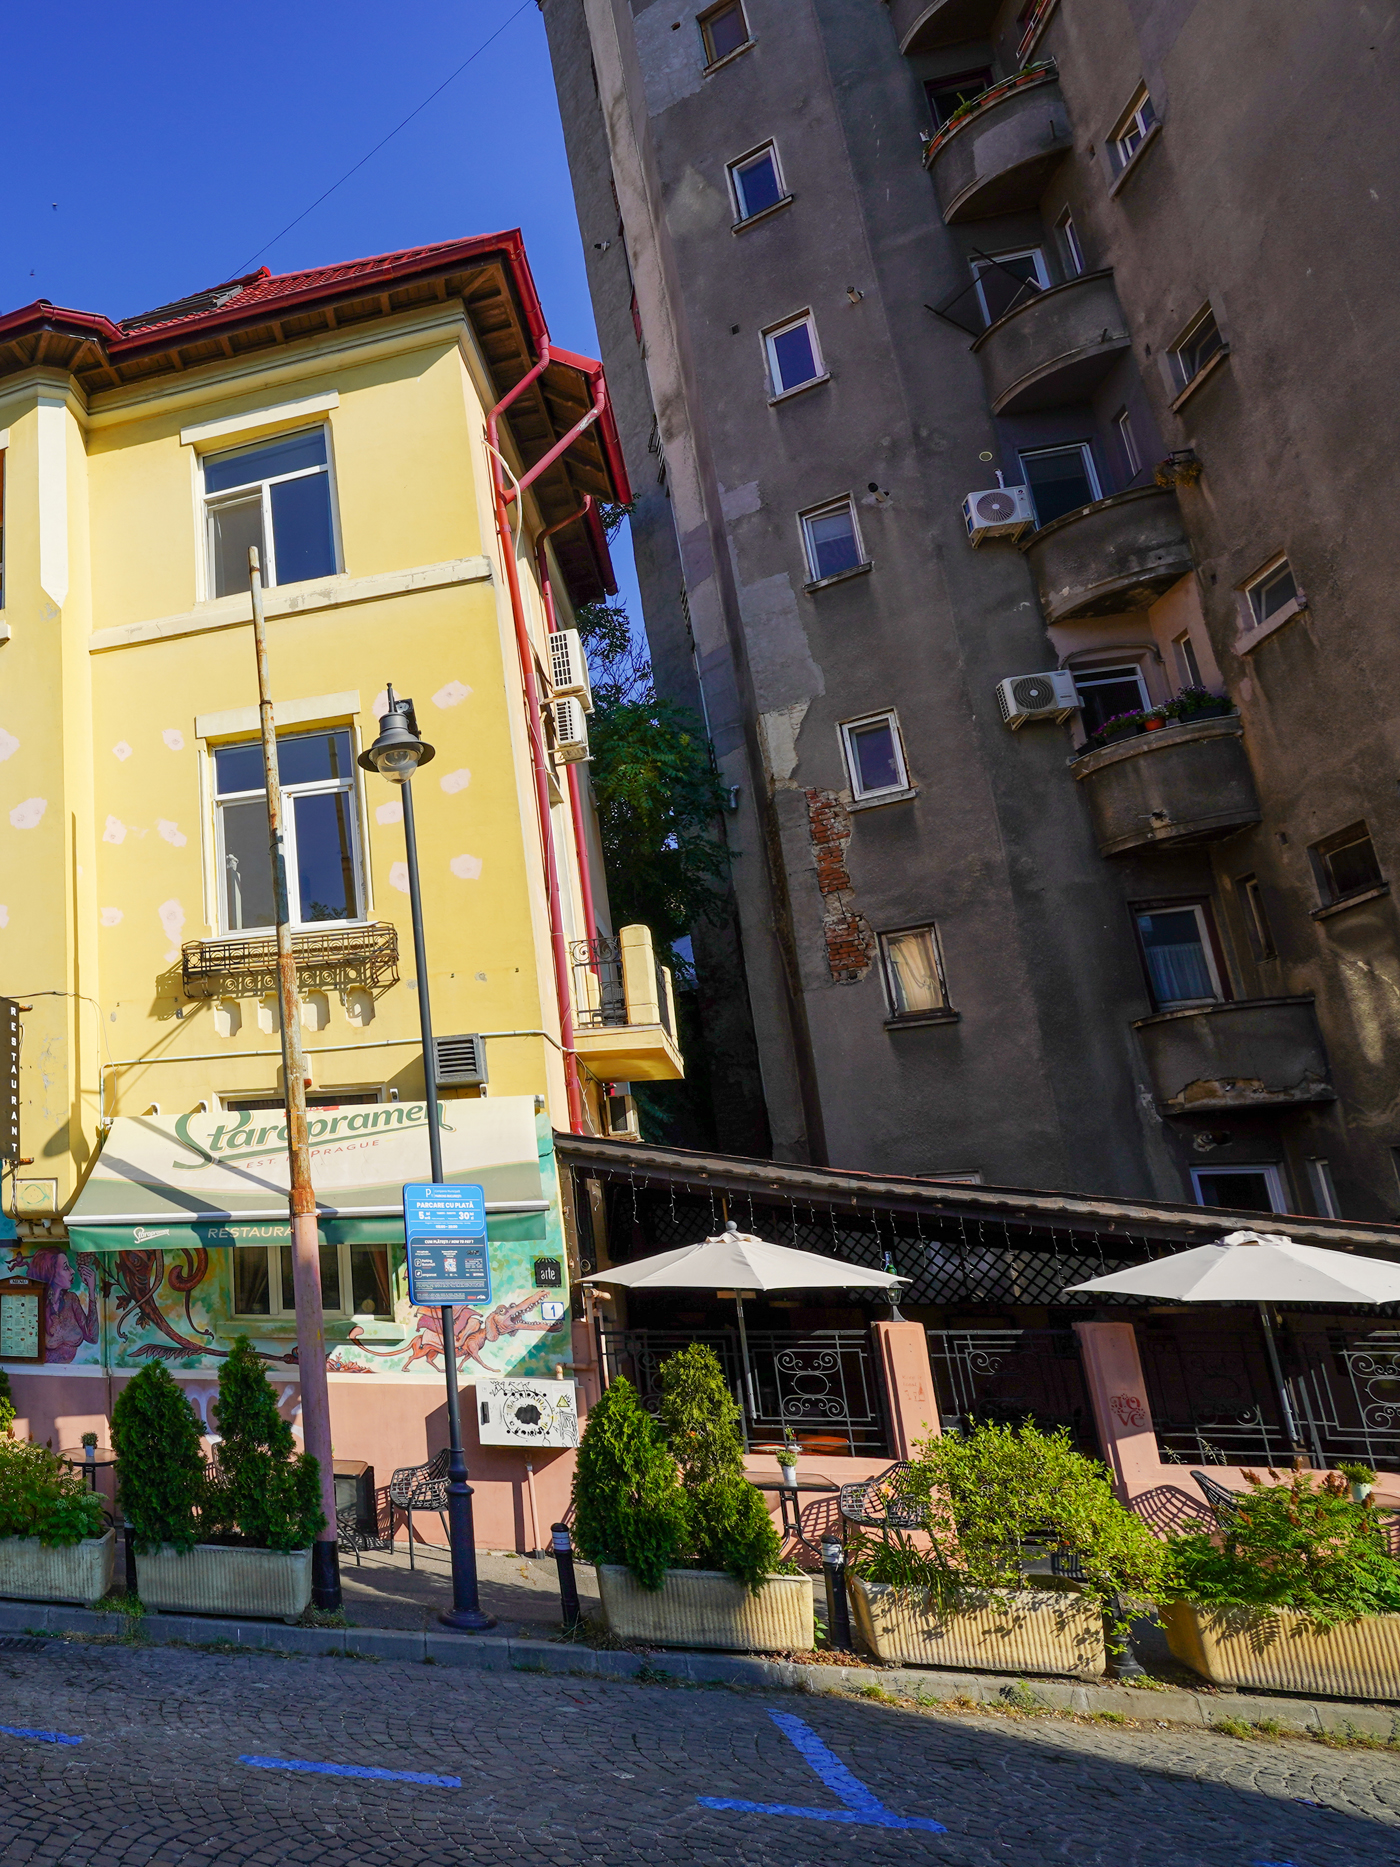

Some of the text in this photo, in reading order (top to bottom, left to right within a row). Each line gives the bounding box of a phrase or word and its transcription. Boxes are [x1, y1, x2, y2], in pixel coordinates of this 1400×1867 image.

[10, 1006, 18, 1153] RESTAURANT
[310, 1139, 381, 1158] PRAGUE
[418, 1211, 424, 1220] 5
[458, 1211, 470, 1220] 30
[207, 1226, 294, 1239] RESTAURA
[540, 1266, 556, 1280] arte
[550, 1304, 556, 1318] 1
